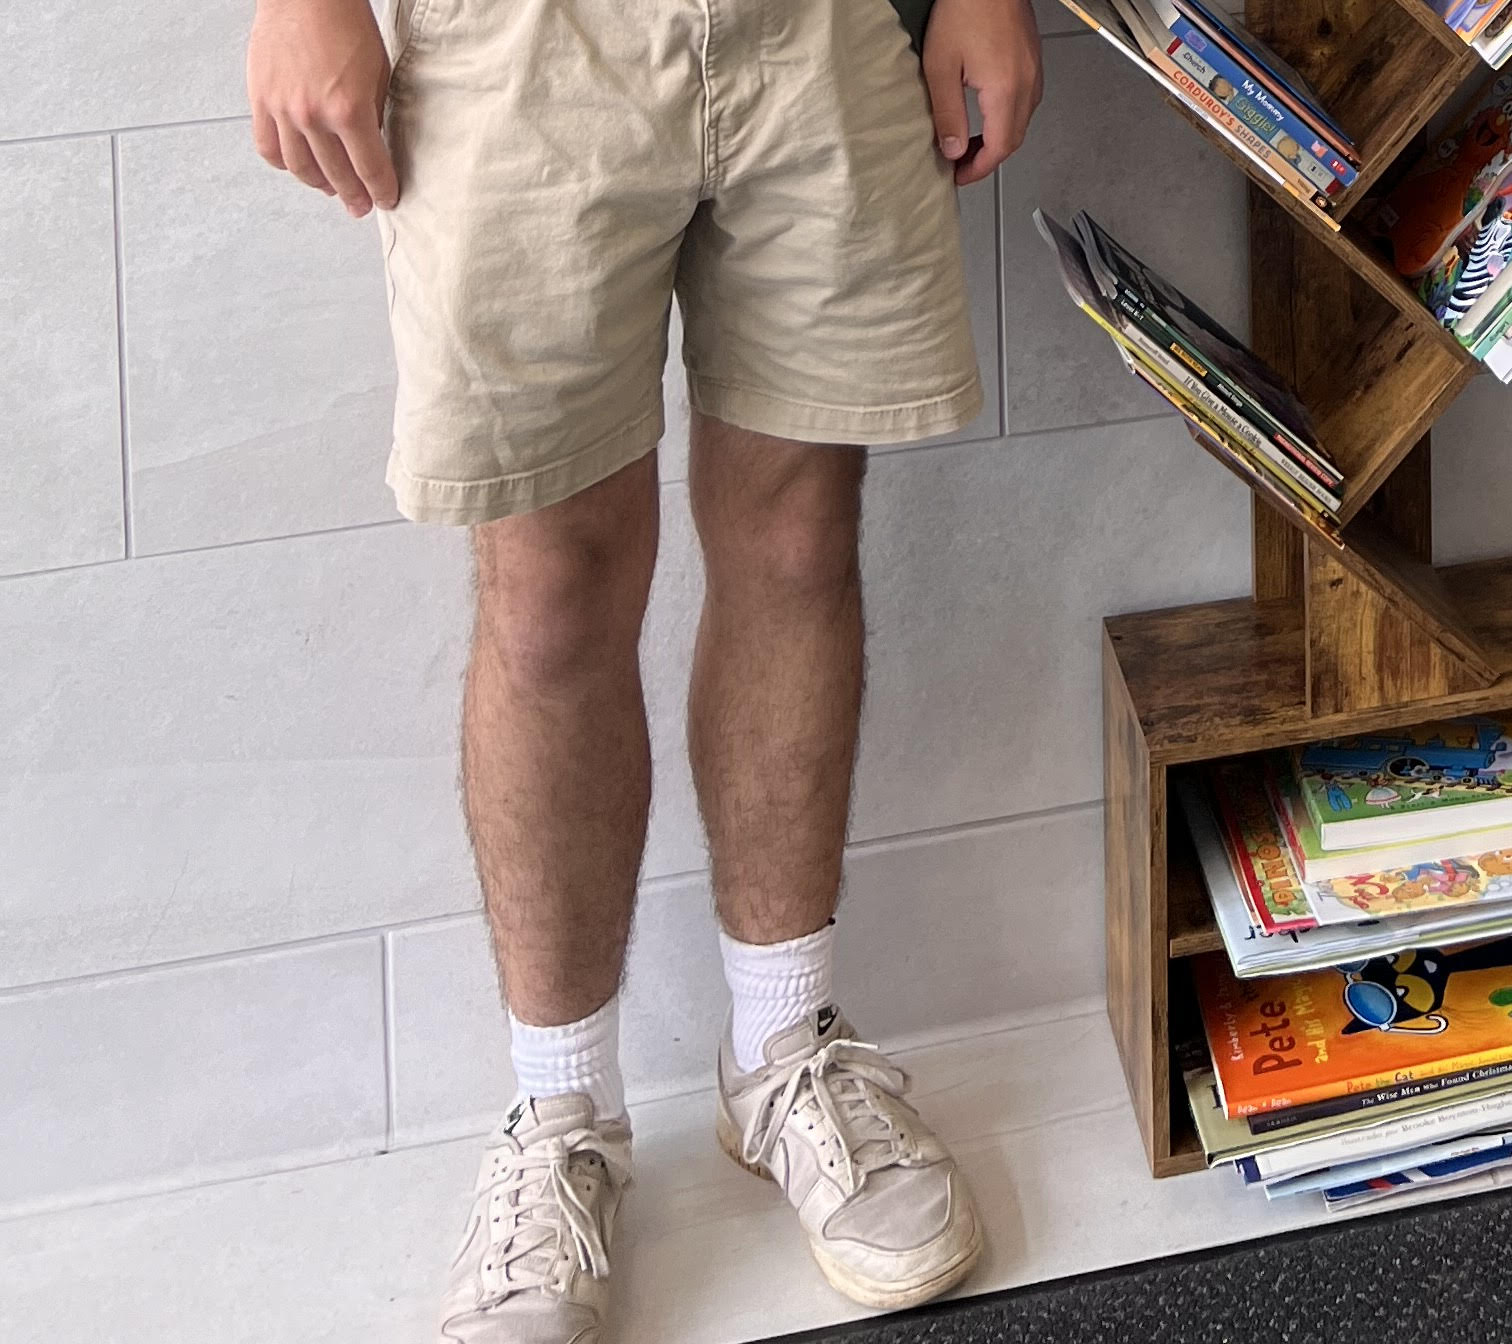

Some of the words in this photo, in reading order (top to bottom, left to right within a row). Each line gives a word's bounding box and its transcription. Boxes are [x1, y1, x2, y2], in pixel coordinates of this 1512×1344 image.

[1170, 68, 1237, 127] CORDUROY'S
[1233, 124, 1272, 159] SHAPES
[1240, 78, 1258, 96] My
[1252, 89, 1288, 122] Mommy
[1182, 375, 1194, 387] If
[1189, 381, 1204, 396] You
[1198, 389, 1217, 408] Give
[1216, 404, 1240, 427] Mouse
[1238, 424, 1264, 449] Cookie
[1249, 1002, 1302, 1076] Pete
[1346, 1077, 1372, 1093] Pete
[1394, 1069, 1414, 1082] Cat
[1361, 1096, 1374, 1105] The
[1376, 1090, 1397, 1101] Wise
[1400, 1084, 1420, 1096] Men
[1440, 1072, 1470, 1087] Found
